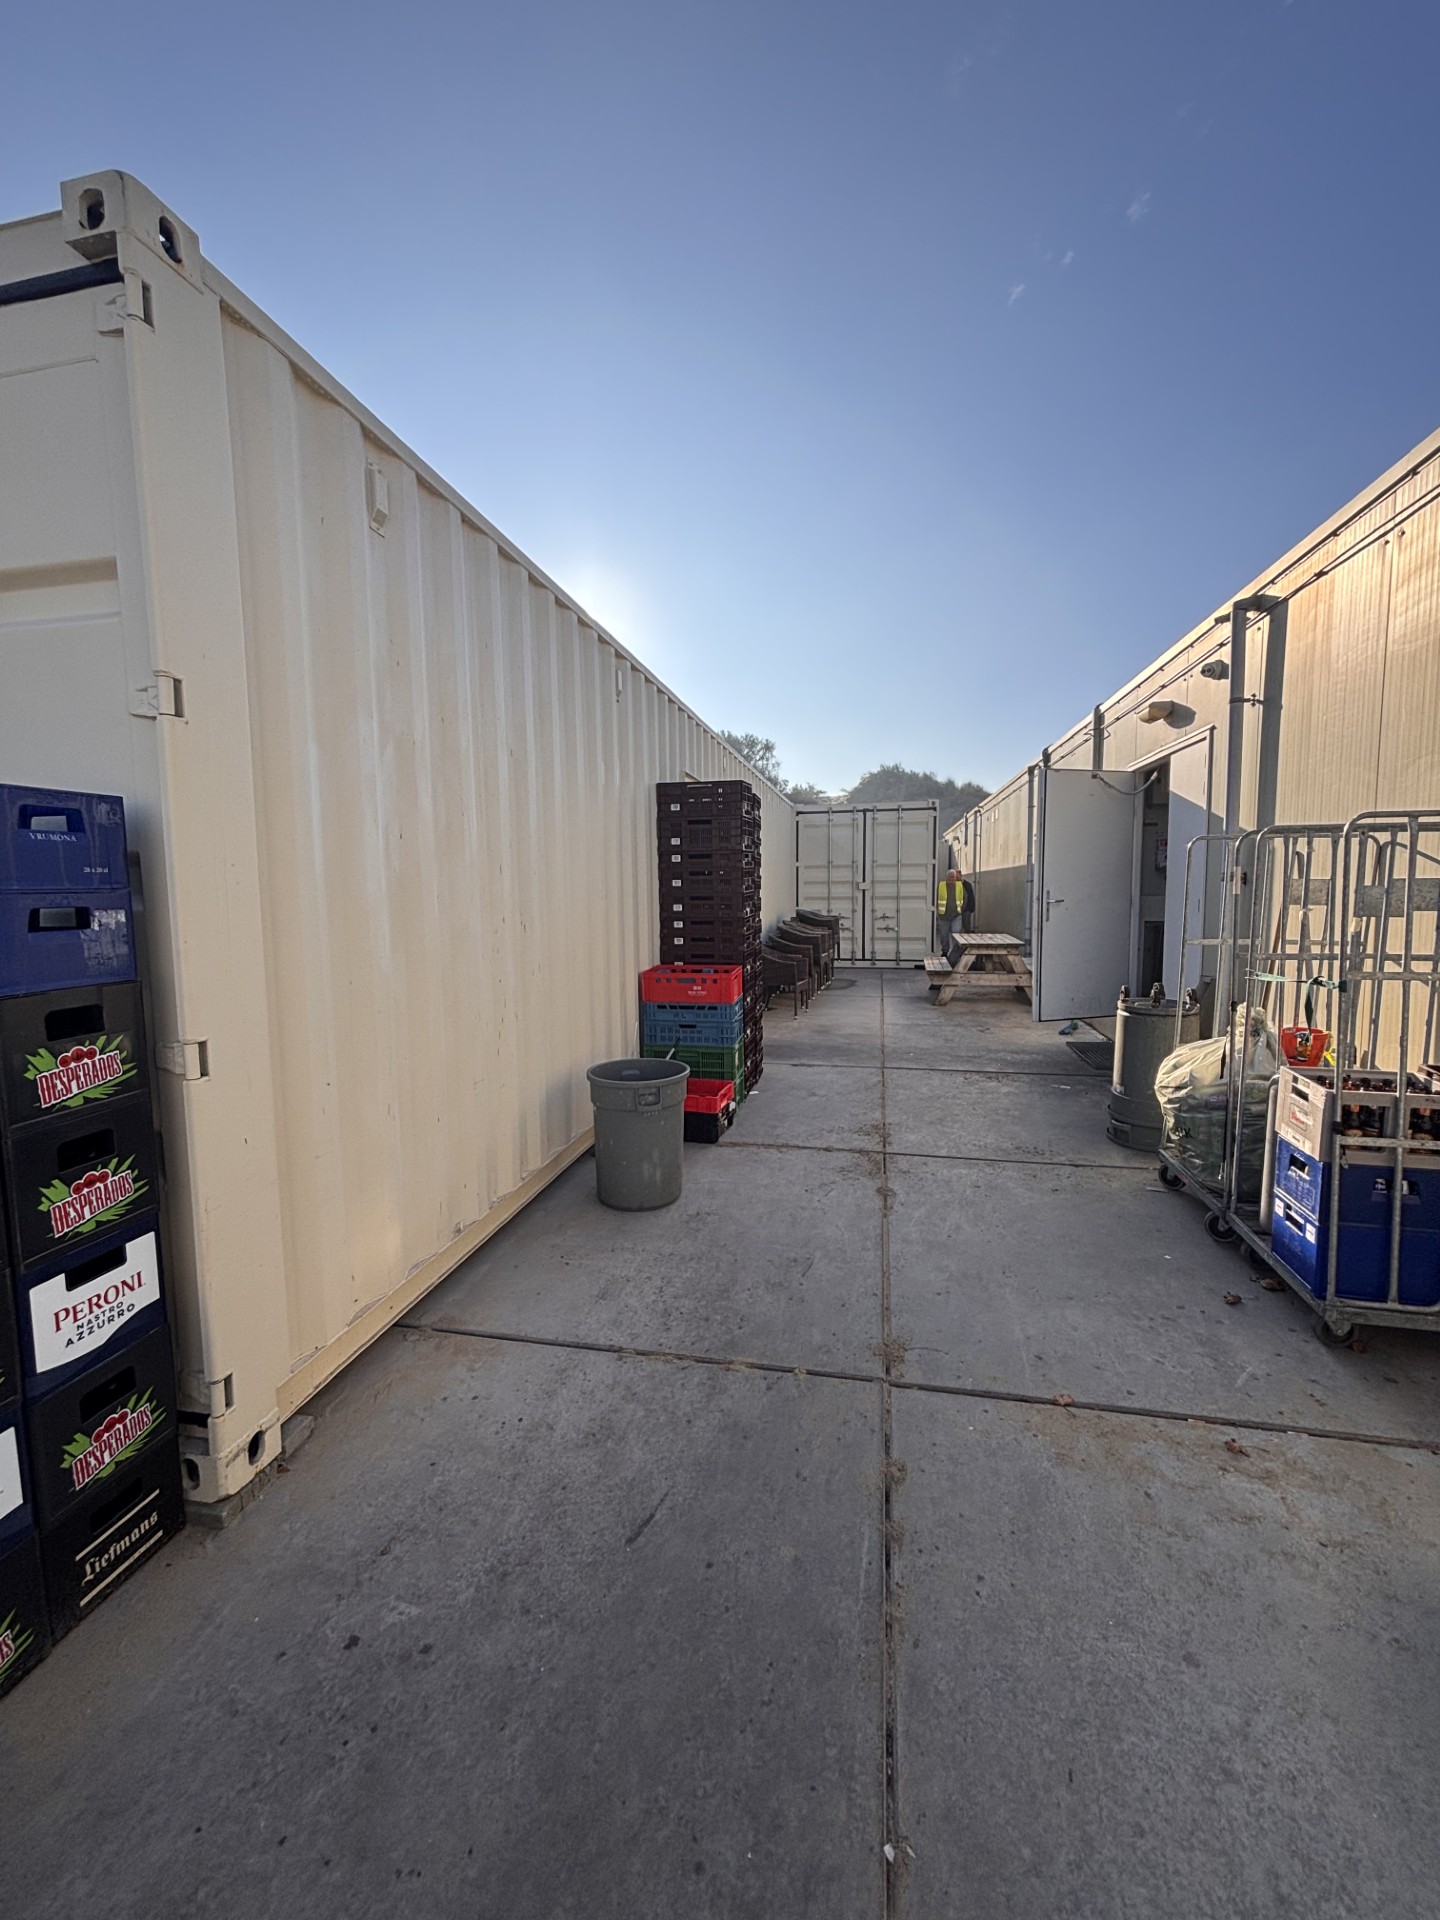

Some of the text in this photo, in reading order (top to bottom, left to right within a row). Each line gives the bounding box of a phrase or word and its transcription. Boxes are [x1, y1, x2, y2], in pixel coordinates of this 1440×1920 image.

[29, 832, 77, 842] VRUMONA
[38, 1051, 122, 1107] DESPERADOS
[51, 1171, 134, 1236] DESPERADOS
[53, 1270, 144, 1333] PERONI
[65, 1303, 136, 1349] AZZURRO
[76, 1301, 124, 1332] NASTRO
[73, 1403, 152, 1489] DESPERADOS
[81, 1510, 159, 1587] Liefmans
